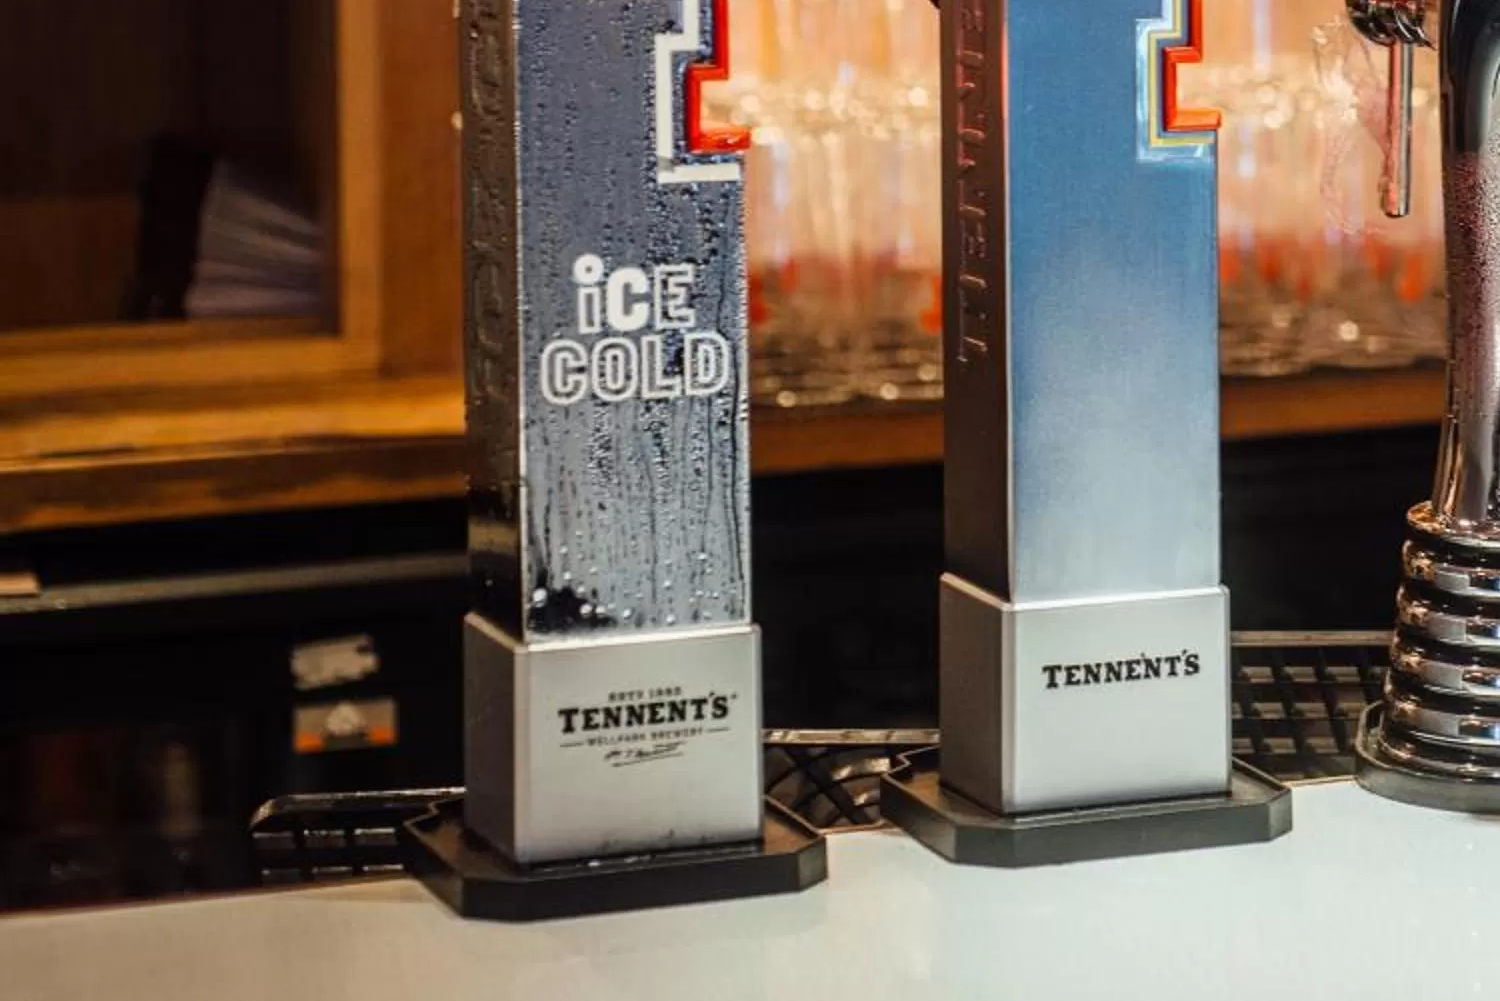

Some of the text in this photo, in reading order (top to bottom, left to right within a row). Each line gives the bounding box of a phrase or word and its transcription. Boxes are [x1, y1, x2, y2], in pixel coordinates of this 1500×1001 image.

[541, 331, 731, 405] COLD
[1042, 649, 1200, 689] TENNENT'S
[557, 691, 730, 735] TENNENT'S
